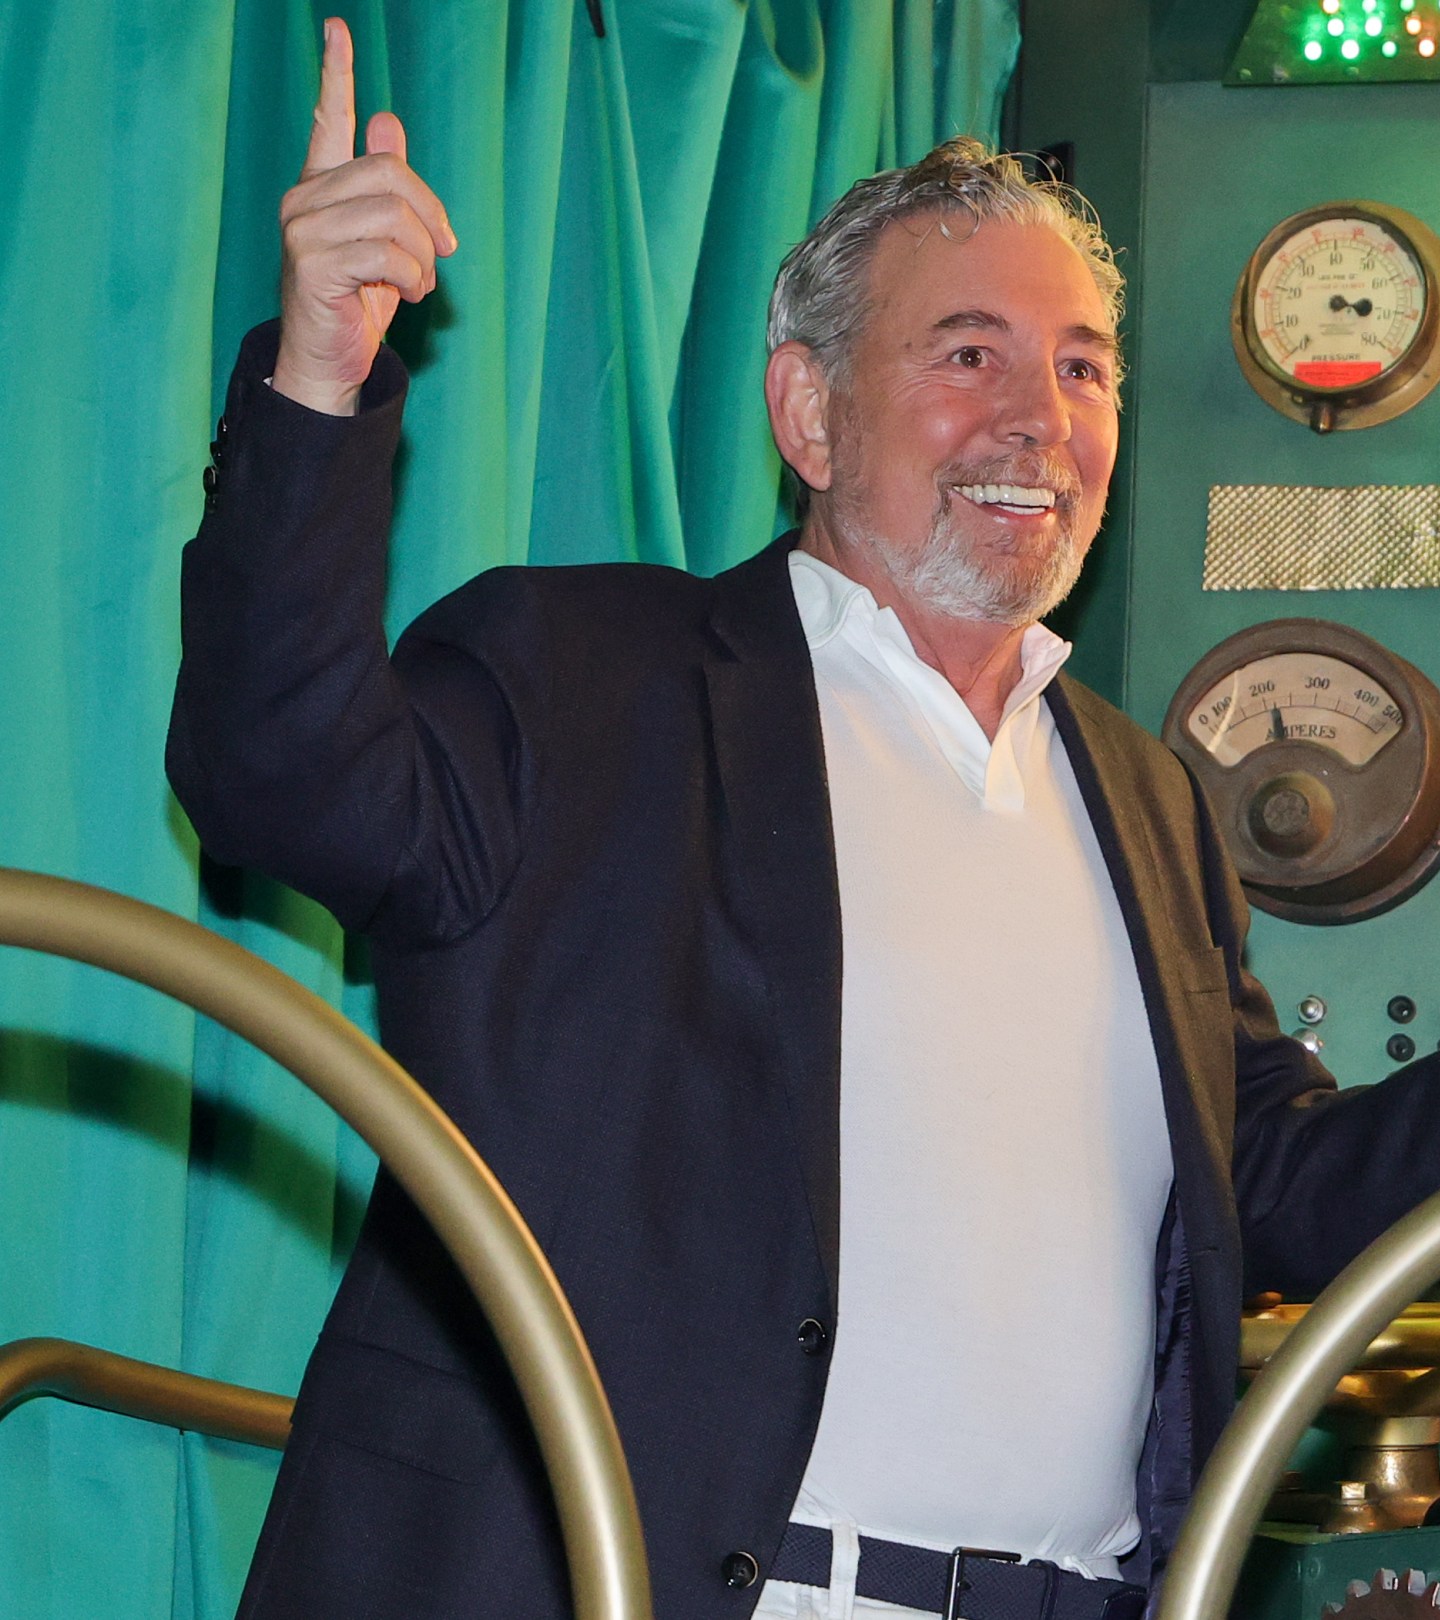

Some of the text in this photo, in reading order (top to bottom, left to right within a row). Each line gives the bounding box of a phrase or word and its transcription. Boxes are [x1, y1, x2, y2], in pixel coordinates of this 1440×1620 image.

[1287, 285, 1302, 299] 20
[1284, 312, 1299, 328] 10
[1312, 353, 1361, 362] PRESSURE
[1249, 679, 1275, 697] 200
[1305, 676, 1331, 690] 300
[1354, 688, 1380, 706] 400
[1211, 696, 1232, 717] 100
[1198, 714, 1209, 725] 0
